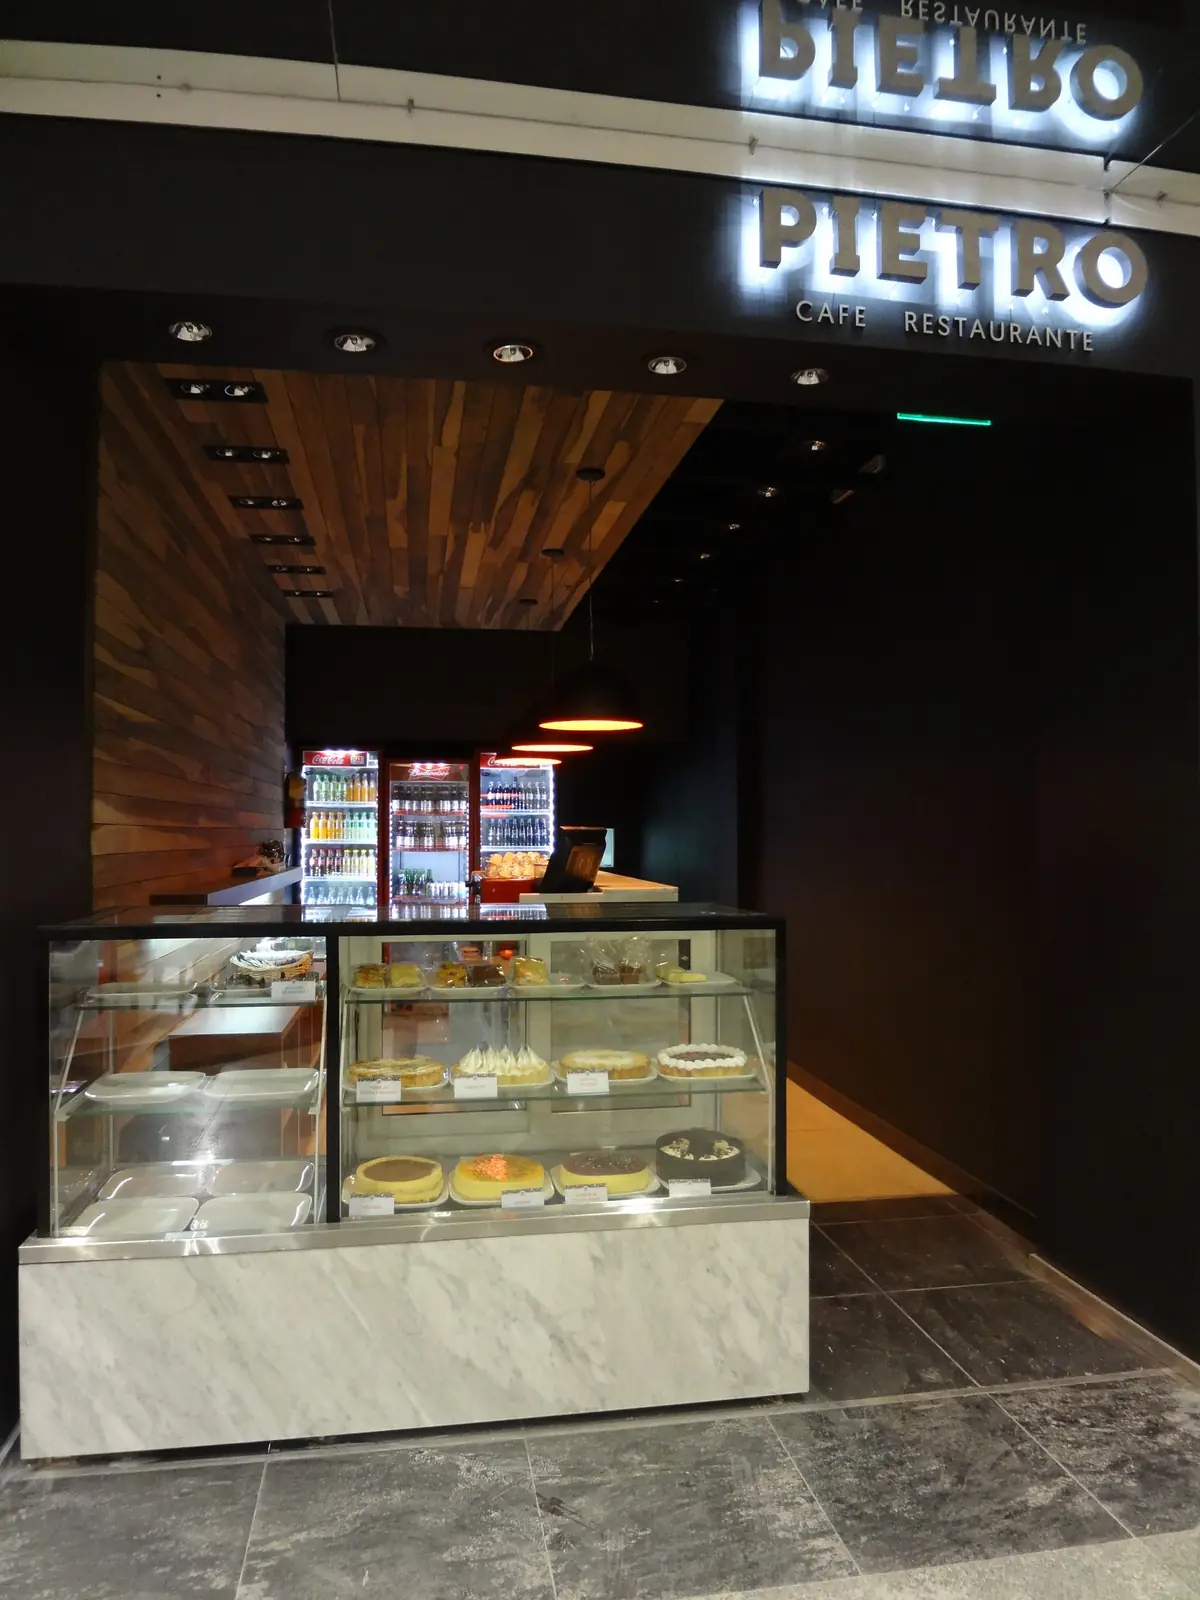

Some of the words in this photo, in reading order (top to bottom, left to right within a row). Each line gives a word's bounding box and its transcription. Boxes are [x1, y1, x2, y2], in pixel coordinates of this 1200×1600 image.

[759, 188, 1148, 308] PIETRO
[795, 300, 867, 328] CAFE
[904, 311, 1095, 352] RESTAURANTE
